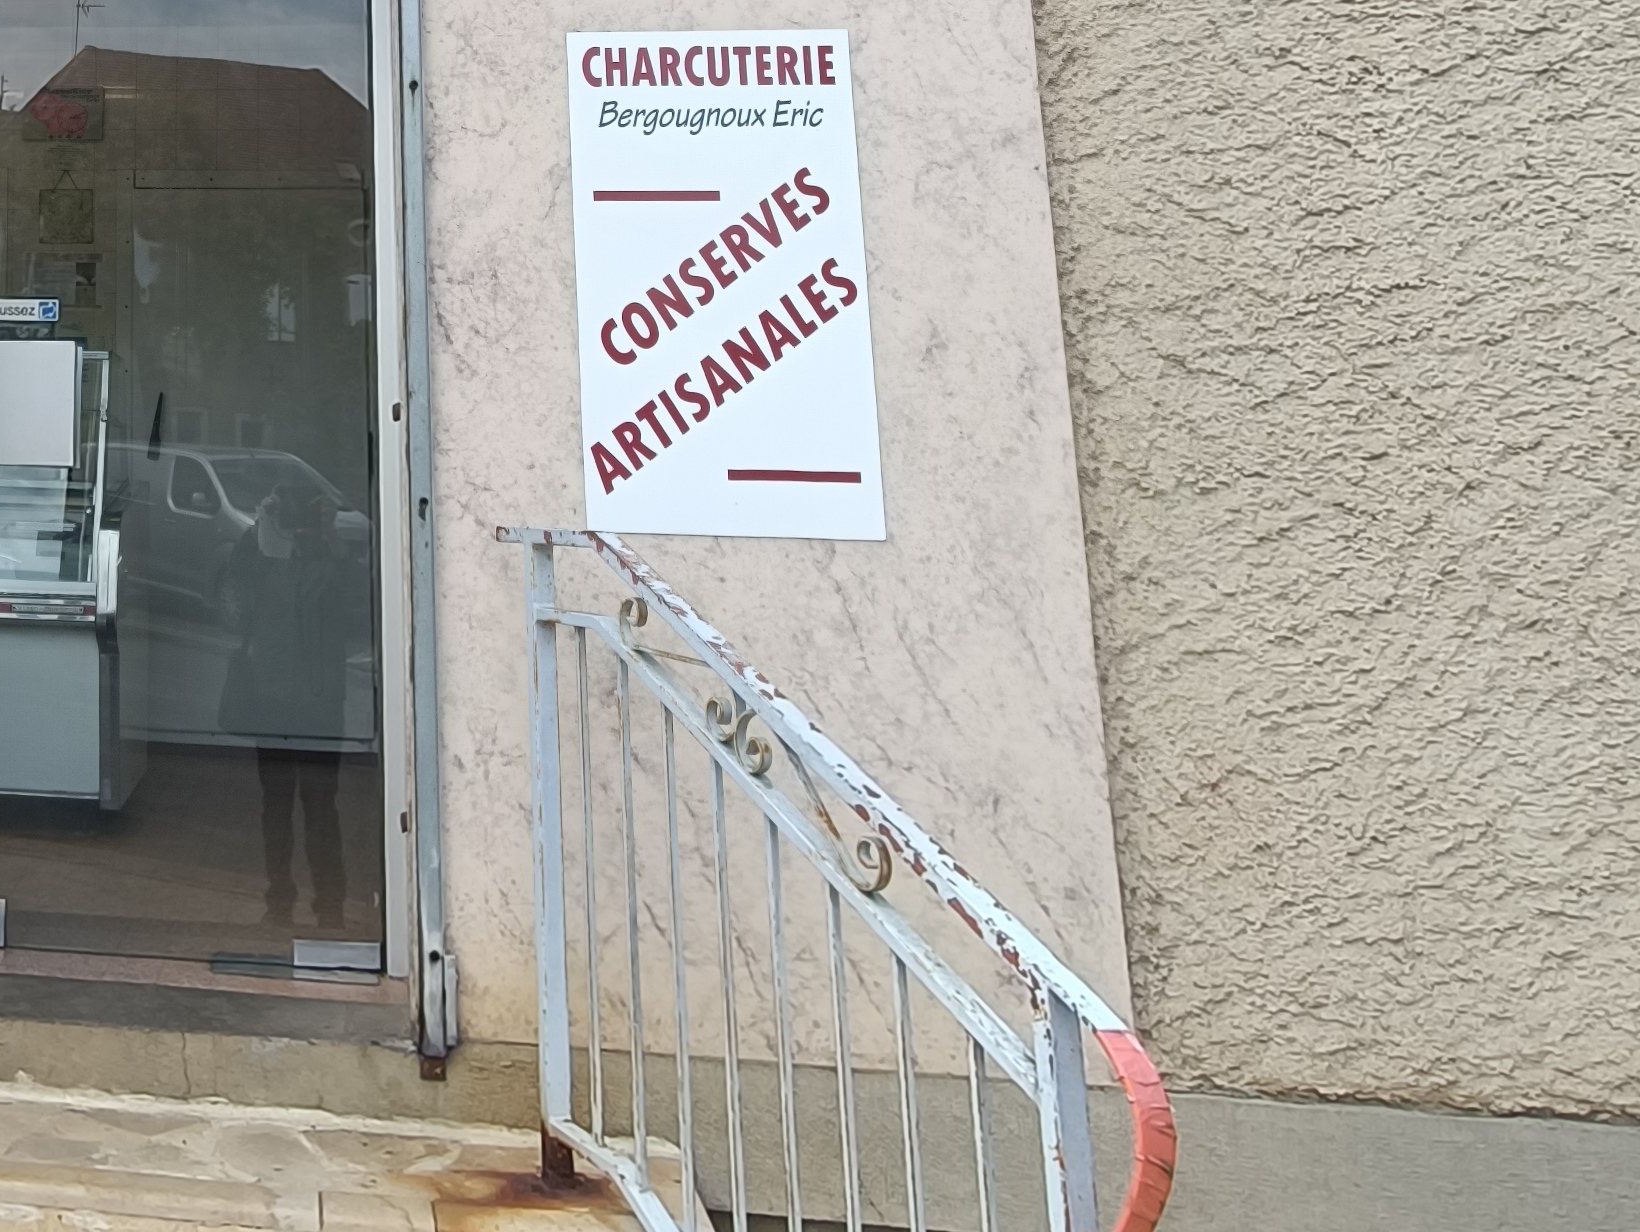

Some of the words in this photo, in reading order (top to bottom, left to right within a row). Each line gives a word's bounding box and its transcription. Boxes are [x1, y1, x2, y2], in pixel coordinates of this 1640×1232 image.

[581, 45, 837, 87] CHARCUTERIE
[598, 99, 766, 136] Bergougnoux
[771, 99, 825, 129] Eric
[599, 166, 831, 366] CONSERVES
[589, 257, 859, 496] ARTISANALES
